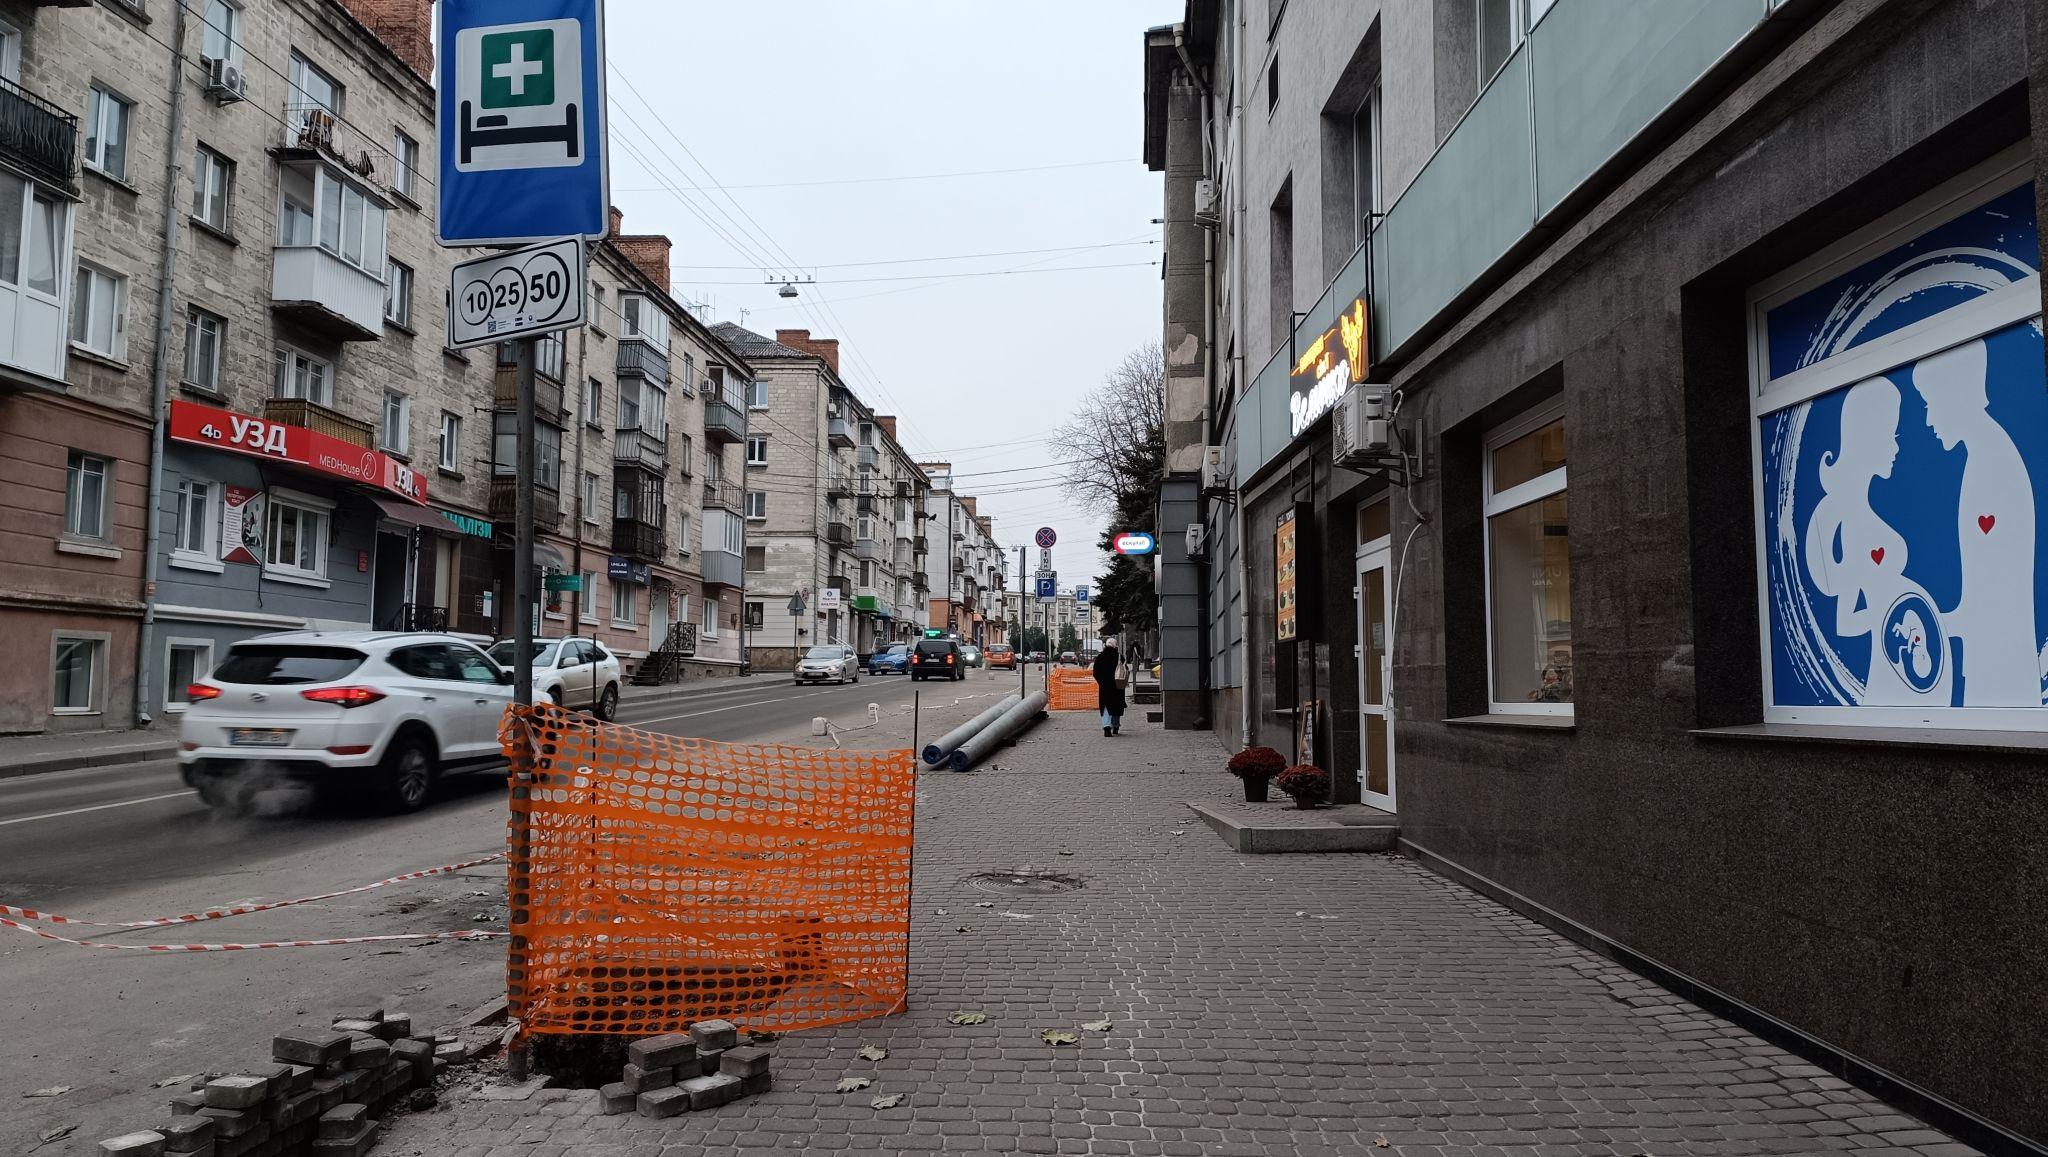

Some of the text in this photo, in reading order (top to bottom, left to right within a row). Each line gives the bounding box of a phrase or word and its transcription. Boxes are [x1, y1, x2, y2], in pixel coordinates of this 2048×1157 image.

[495, 282, 520, 309] 25
[530, 271, 560, 303] 50
[467, 291, 488, 313] 10
[201, 416, 288, 457] 4D УЗД
[319, 454, 361, 476] MEDHouse
[394, 463, 413, 497] УЗД
